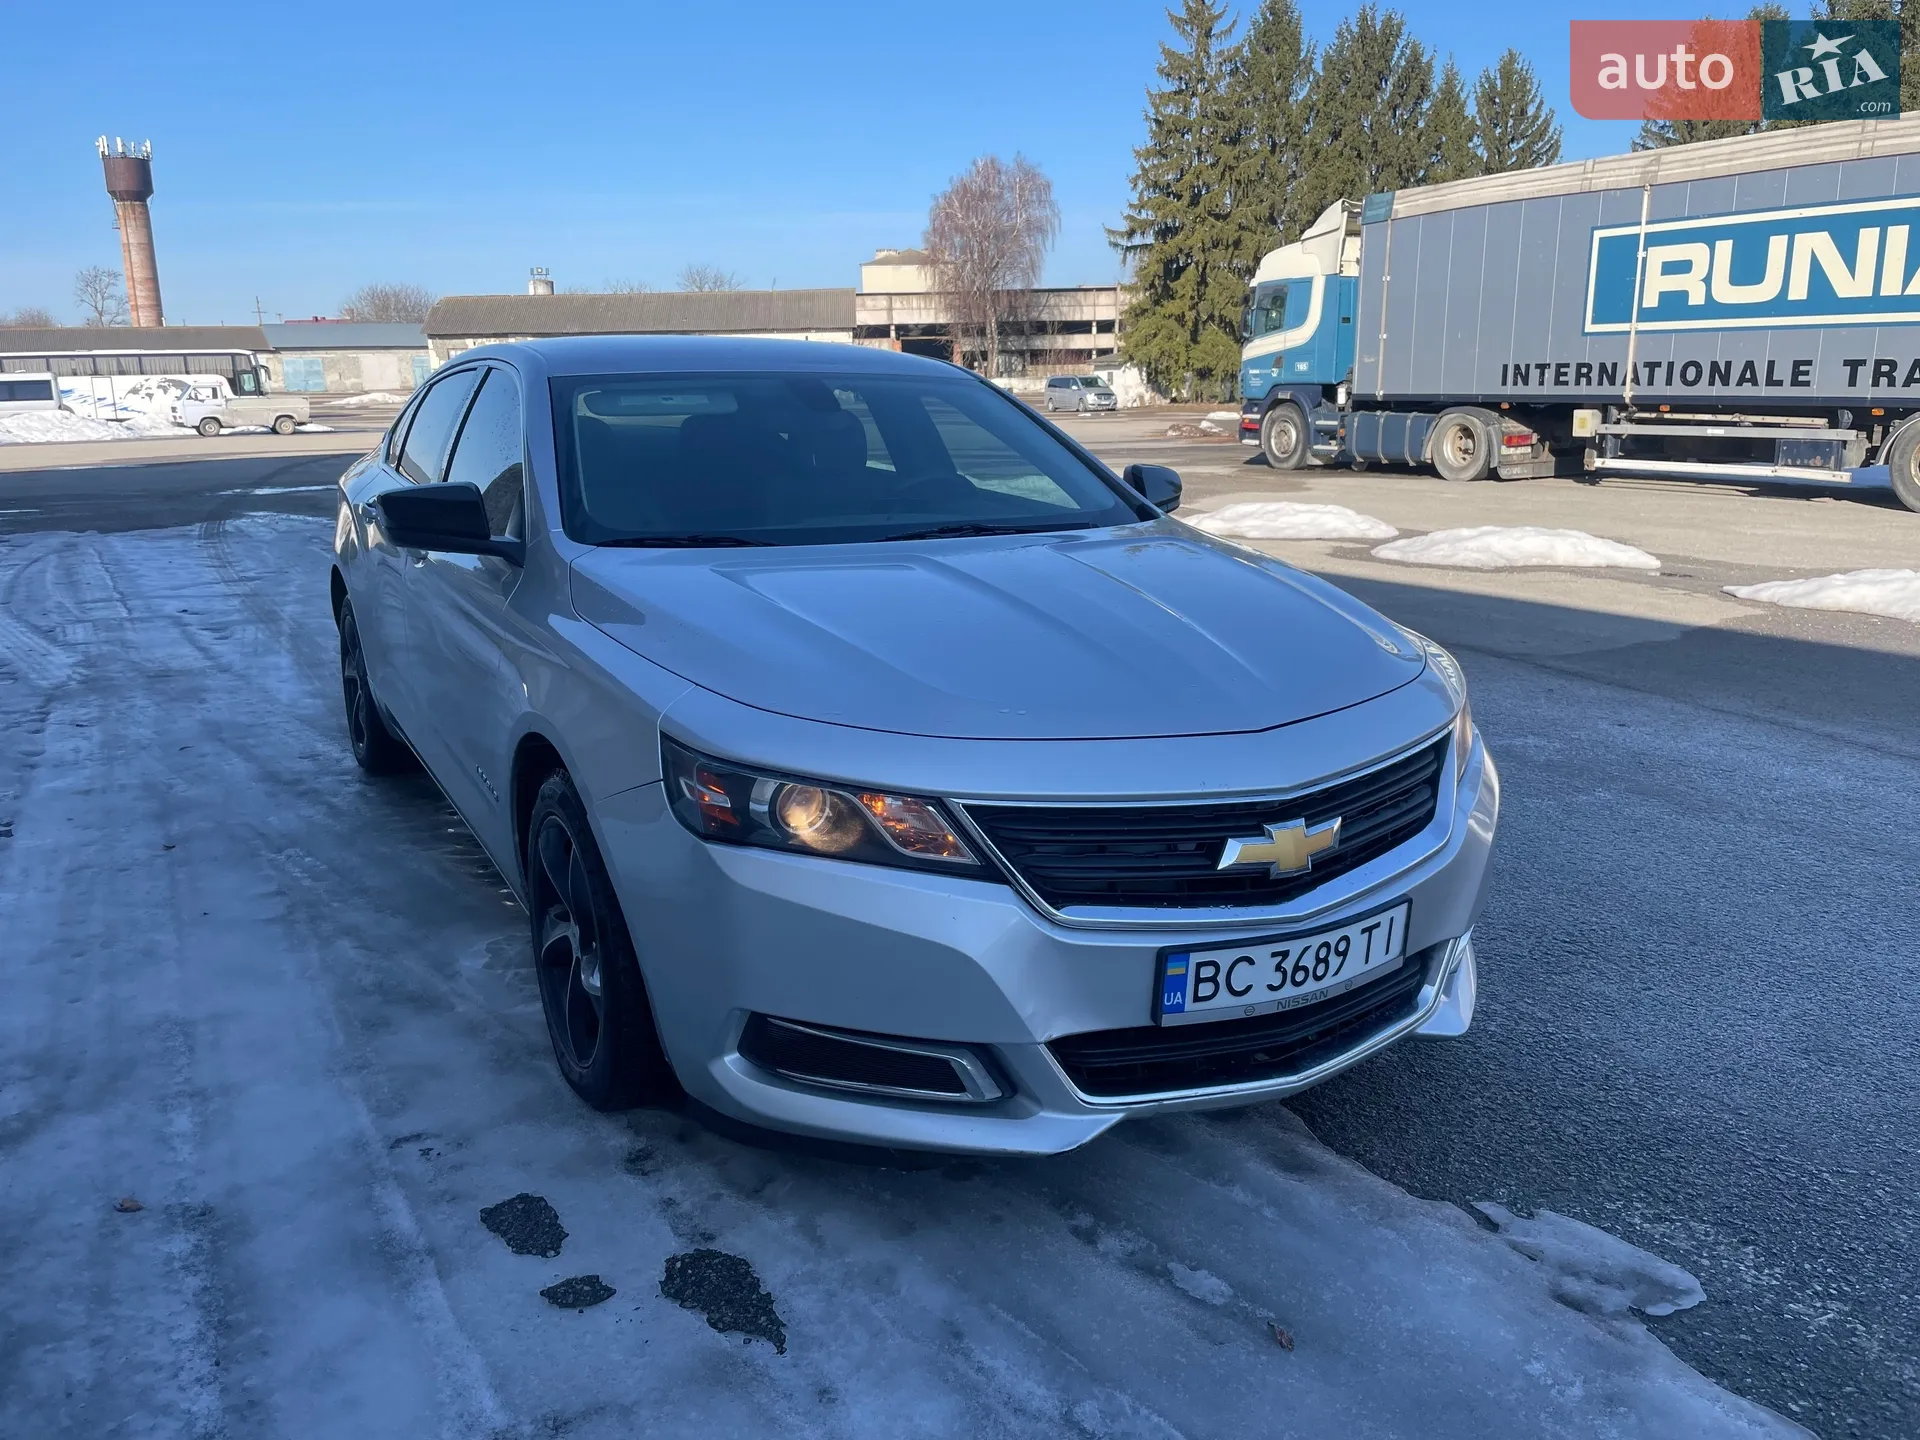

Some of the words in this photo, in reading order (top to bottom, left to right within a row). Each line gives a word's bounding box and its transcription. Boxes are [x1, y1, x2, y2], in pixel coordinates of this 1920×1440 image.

[1642, 225, 1920, 308] RUNI
[1501, 359, 1813, 387] INTERNATIONALE
[1192, 955, 1256, 1003] BC
[1266, 934, 1351, 992] 3689
[1360, 916, 1395, 965] TI
[1164, 991, 1183, 1006] UA
[1276, 988, 1329, 1011] NISSAN
